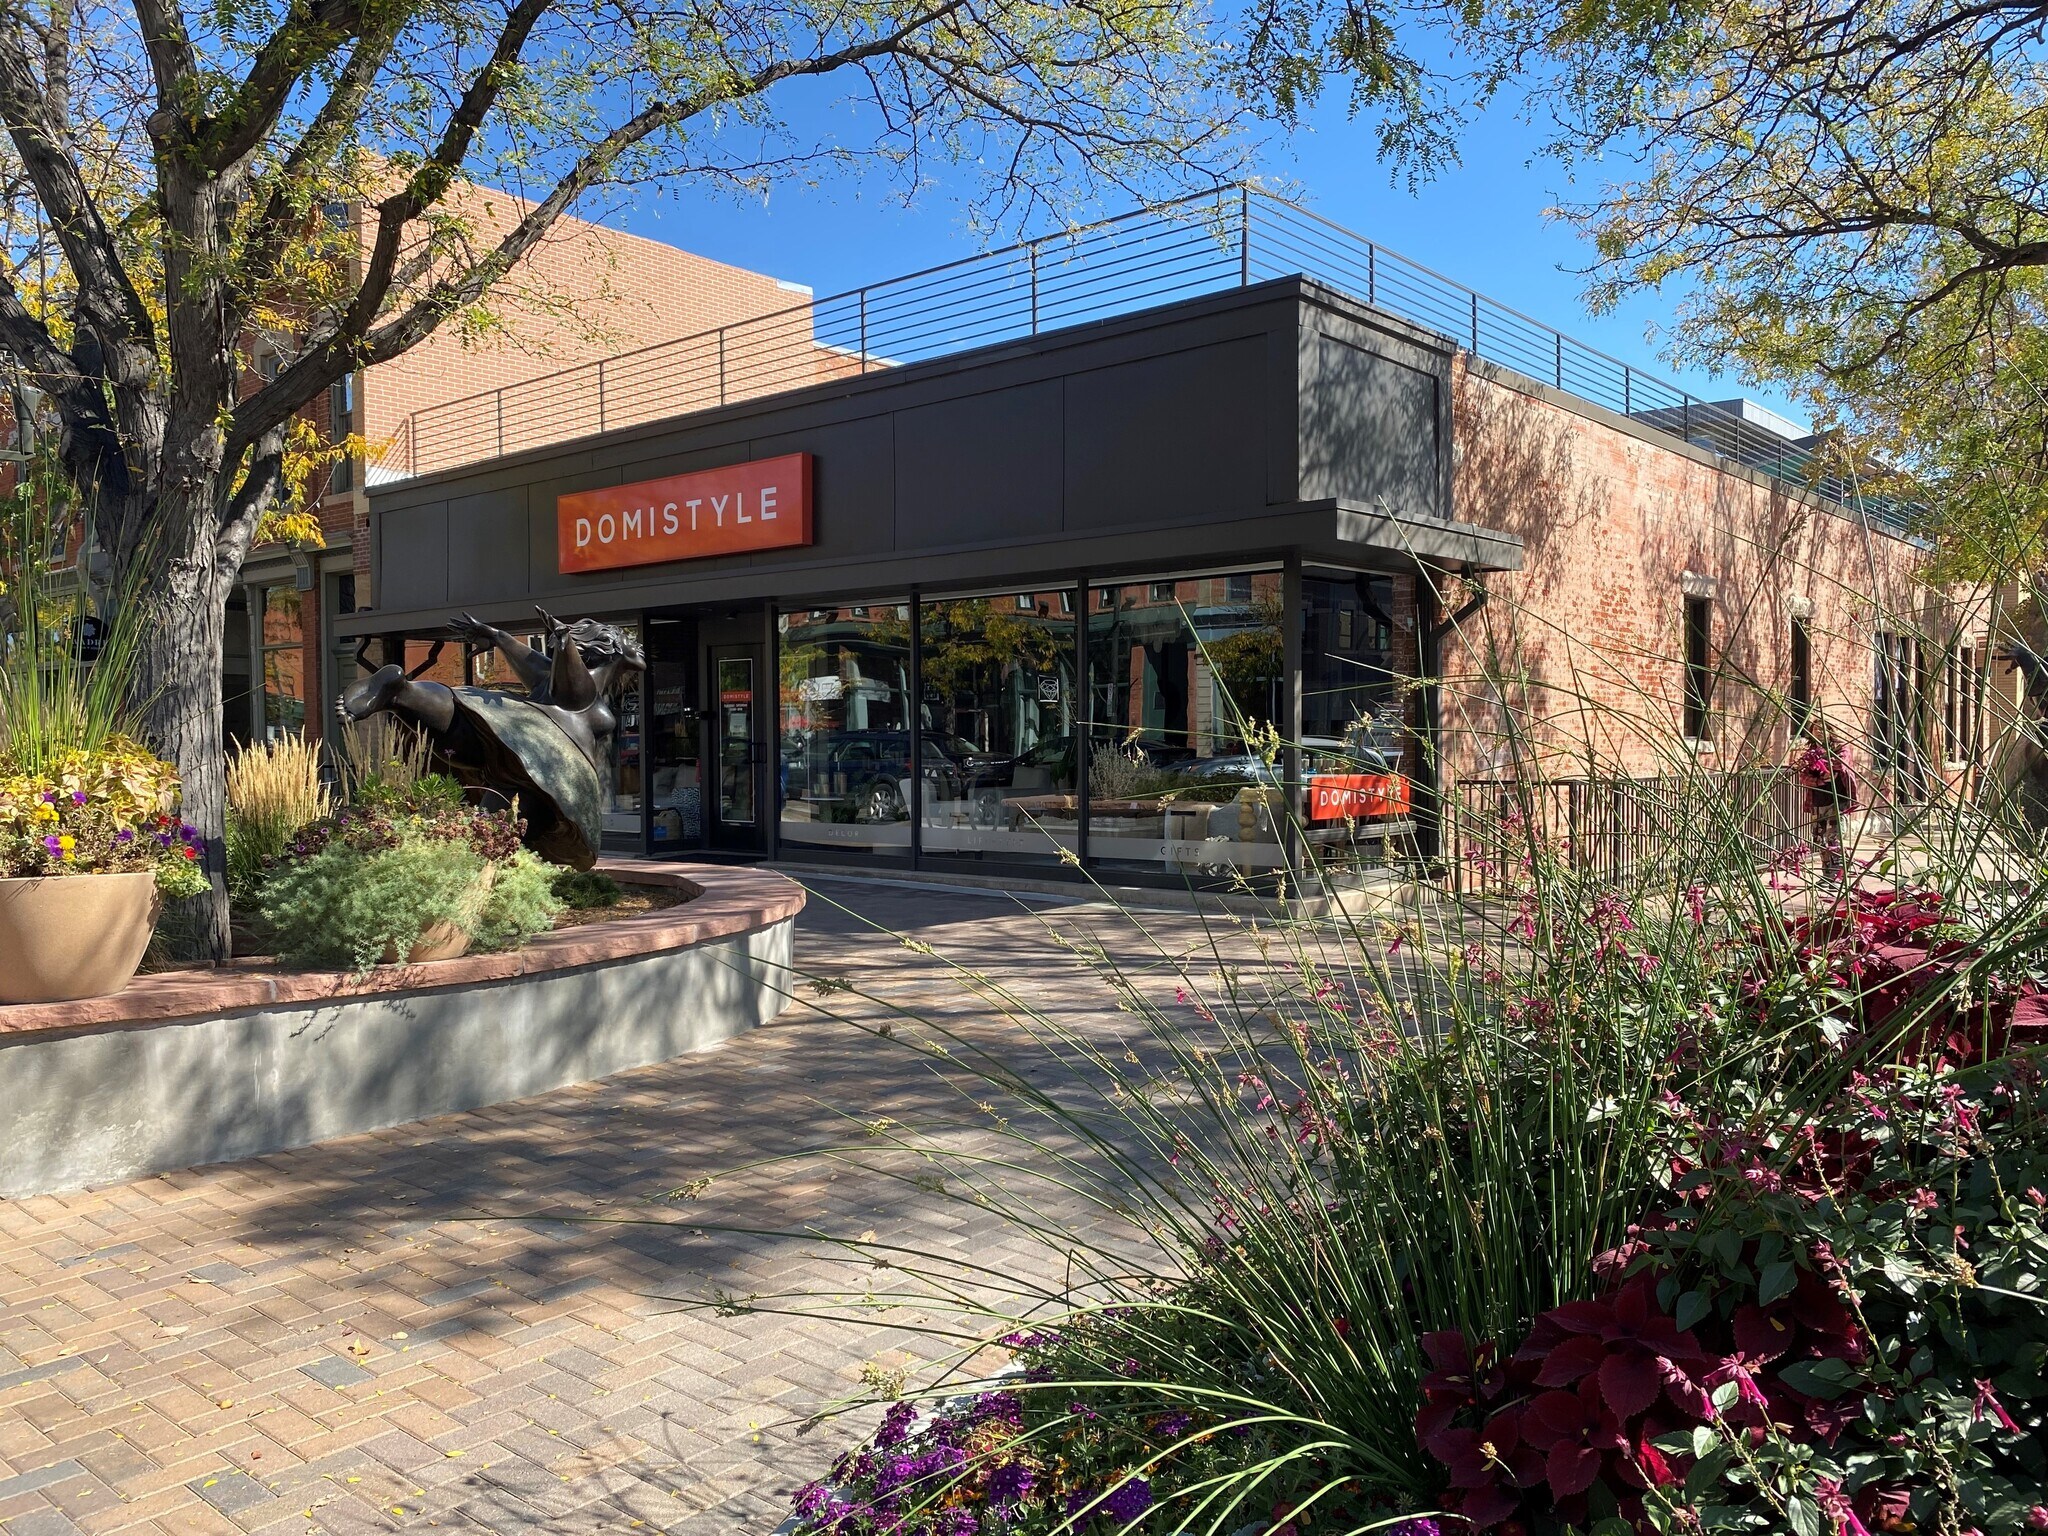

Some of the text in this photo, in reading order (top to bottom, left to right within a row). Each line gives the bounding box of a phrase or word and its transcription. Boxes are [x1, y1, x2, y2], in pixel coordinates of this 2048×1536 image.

[576, 486, 777, 547] DOMISTYLE
[1320, 786, 1402, 807] DOMISTYE
[1160, 846, 1199, 856] GIFTS
